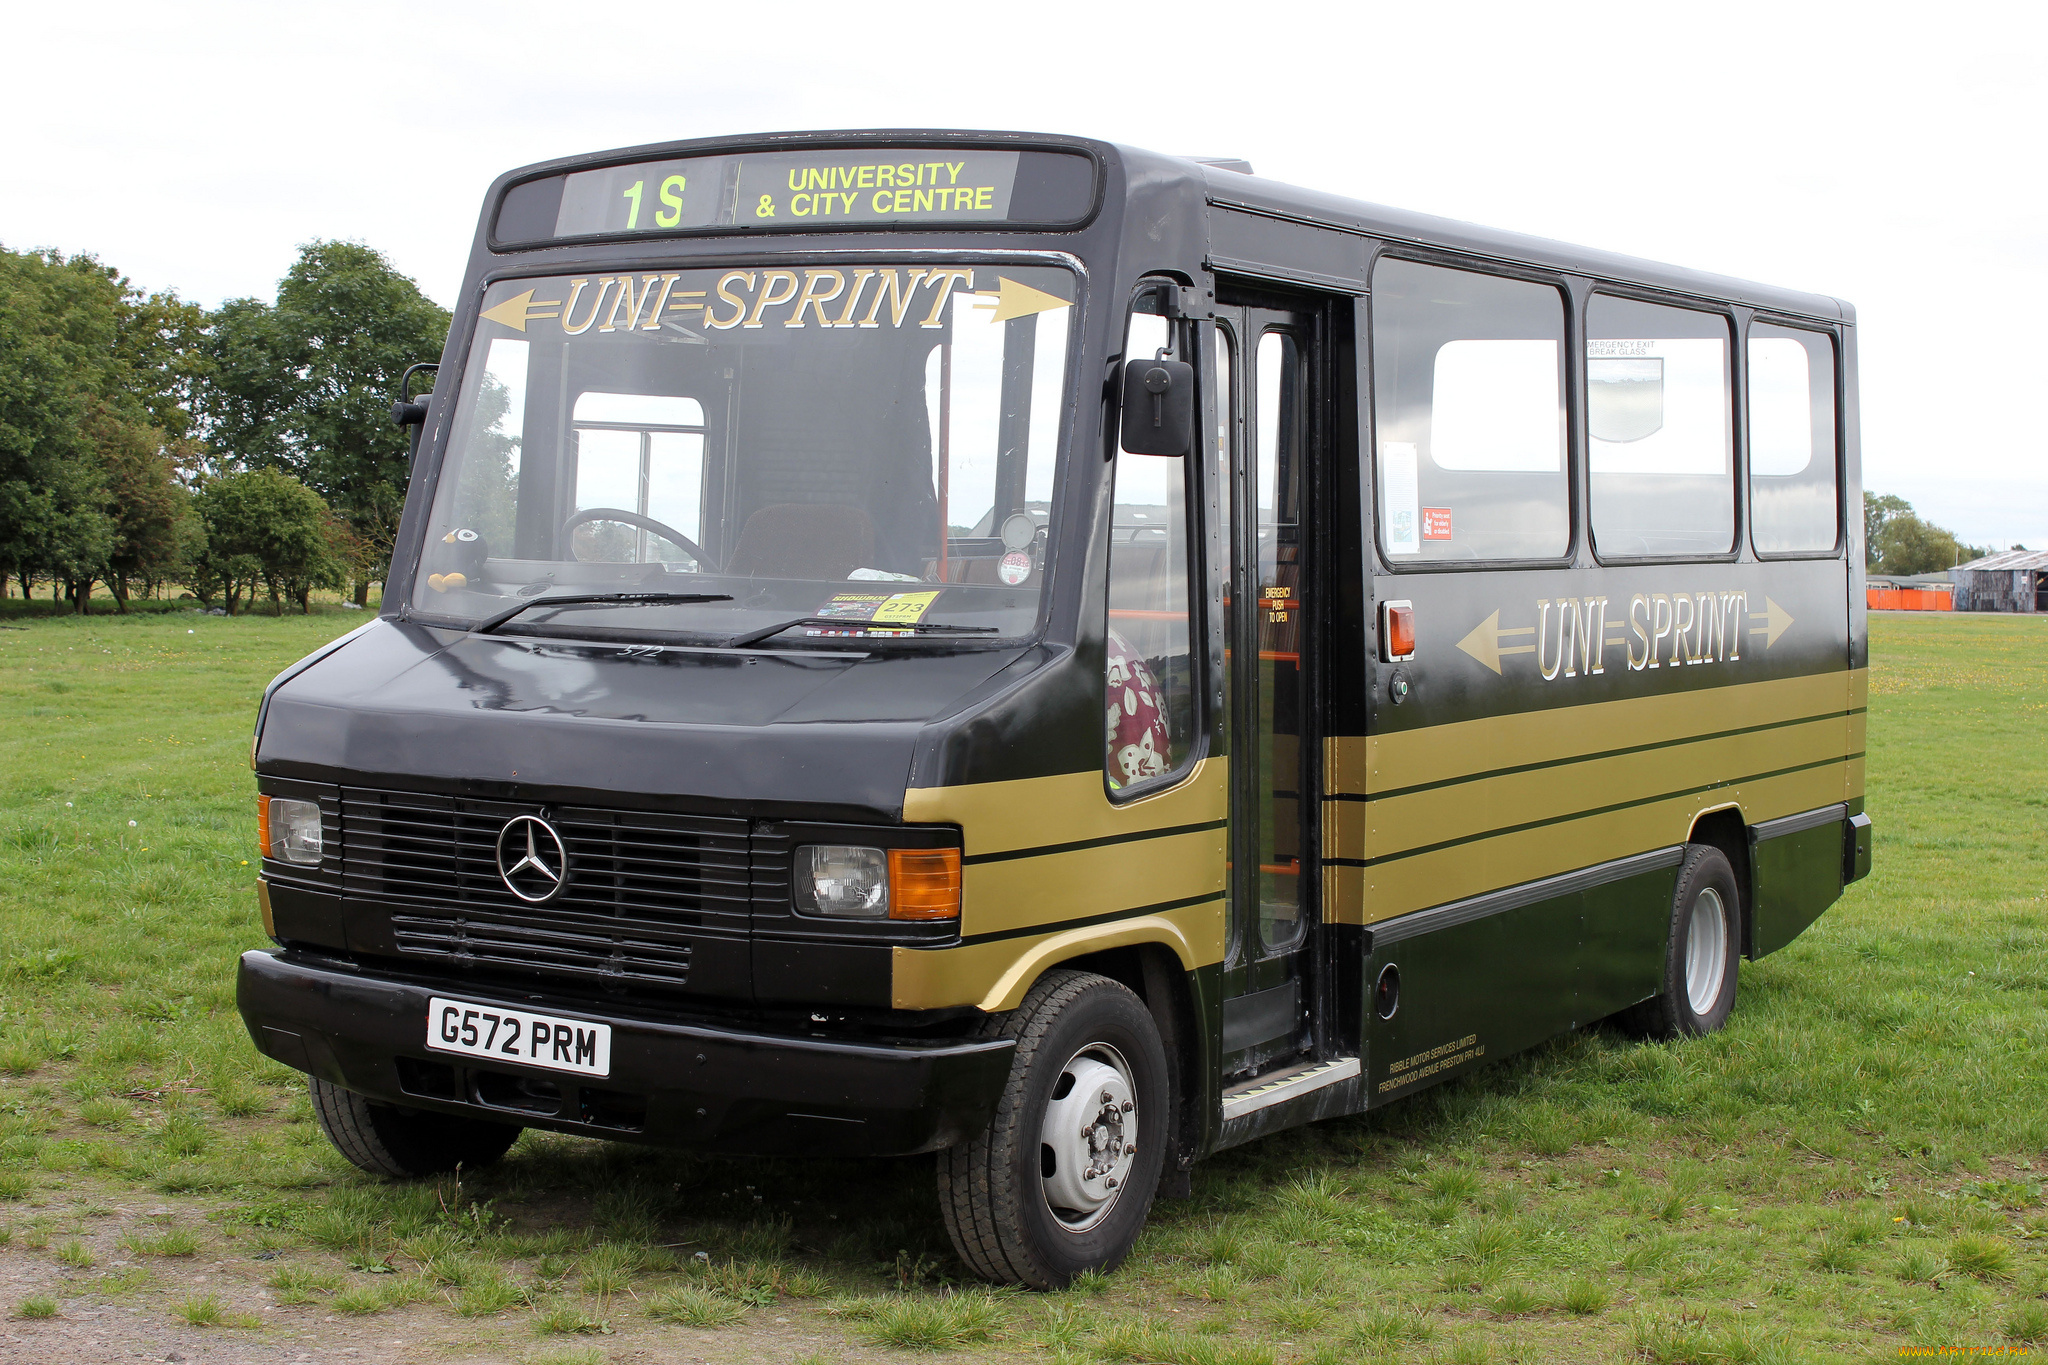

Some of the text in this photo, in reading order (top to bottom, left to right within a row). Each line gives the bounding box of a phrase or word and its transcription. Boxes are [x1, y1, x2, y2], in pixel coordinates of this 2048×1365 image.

[788, 161, 965, 191] UNIVERSITY
[755, 186, 995, 218] & CITY CENTRE
[1266, 587, 1291, 598] EMERGENCY
[884, 603, 925, 612] 273
[1273, 600, 1284, 610] PUSH
[1269, 612, 1287, 622] TO OPEN
[616, 645, 665, 657] 572
[441, 1006, 596, 1067] G572 PRM
[1389, 1033, 1477, 1074] RIBBLE MOTOR SERVICES LIMITED
[1378, 1070, 1419, 1094] FRENCHWOOD
[1418, 1061, 1440, 1078] AVENUE
[1440, 1054, 1464, 1071] PRESTON
[1464, 1049, 1475, 1062] PR1
